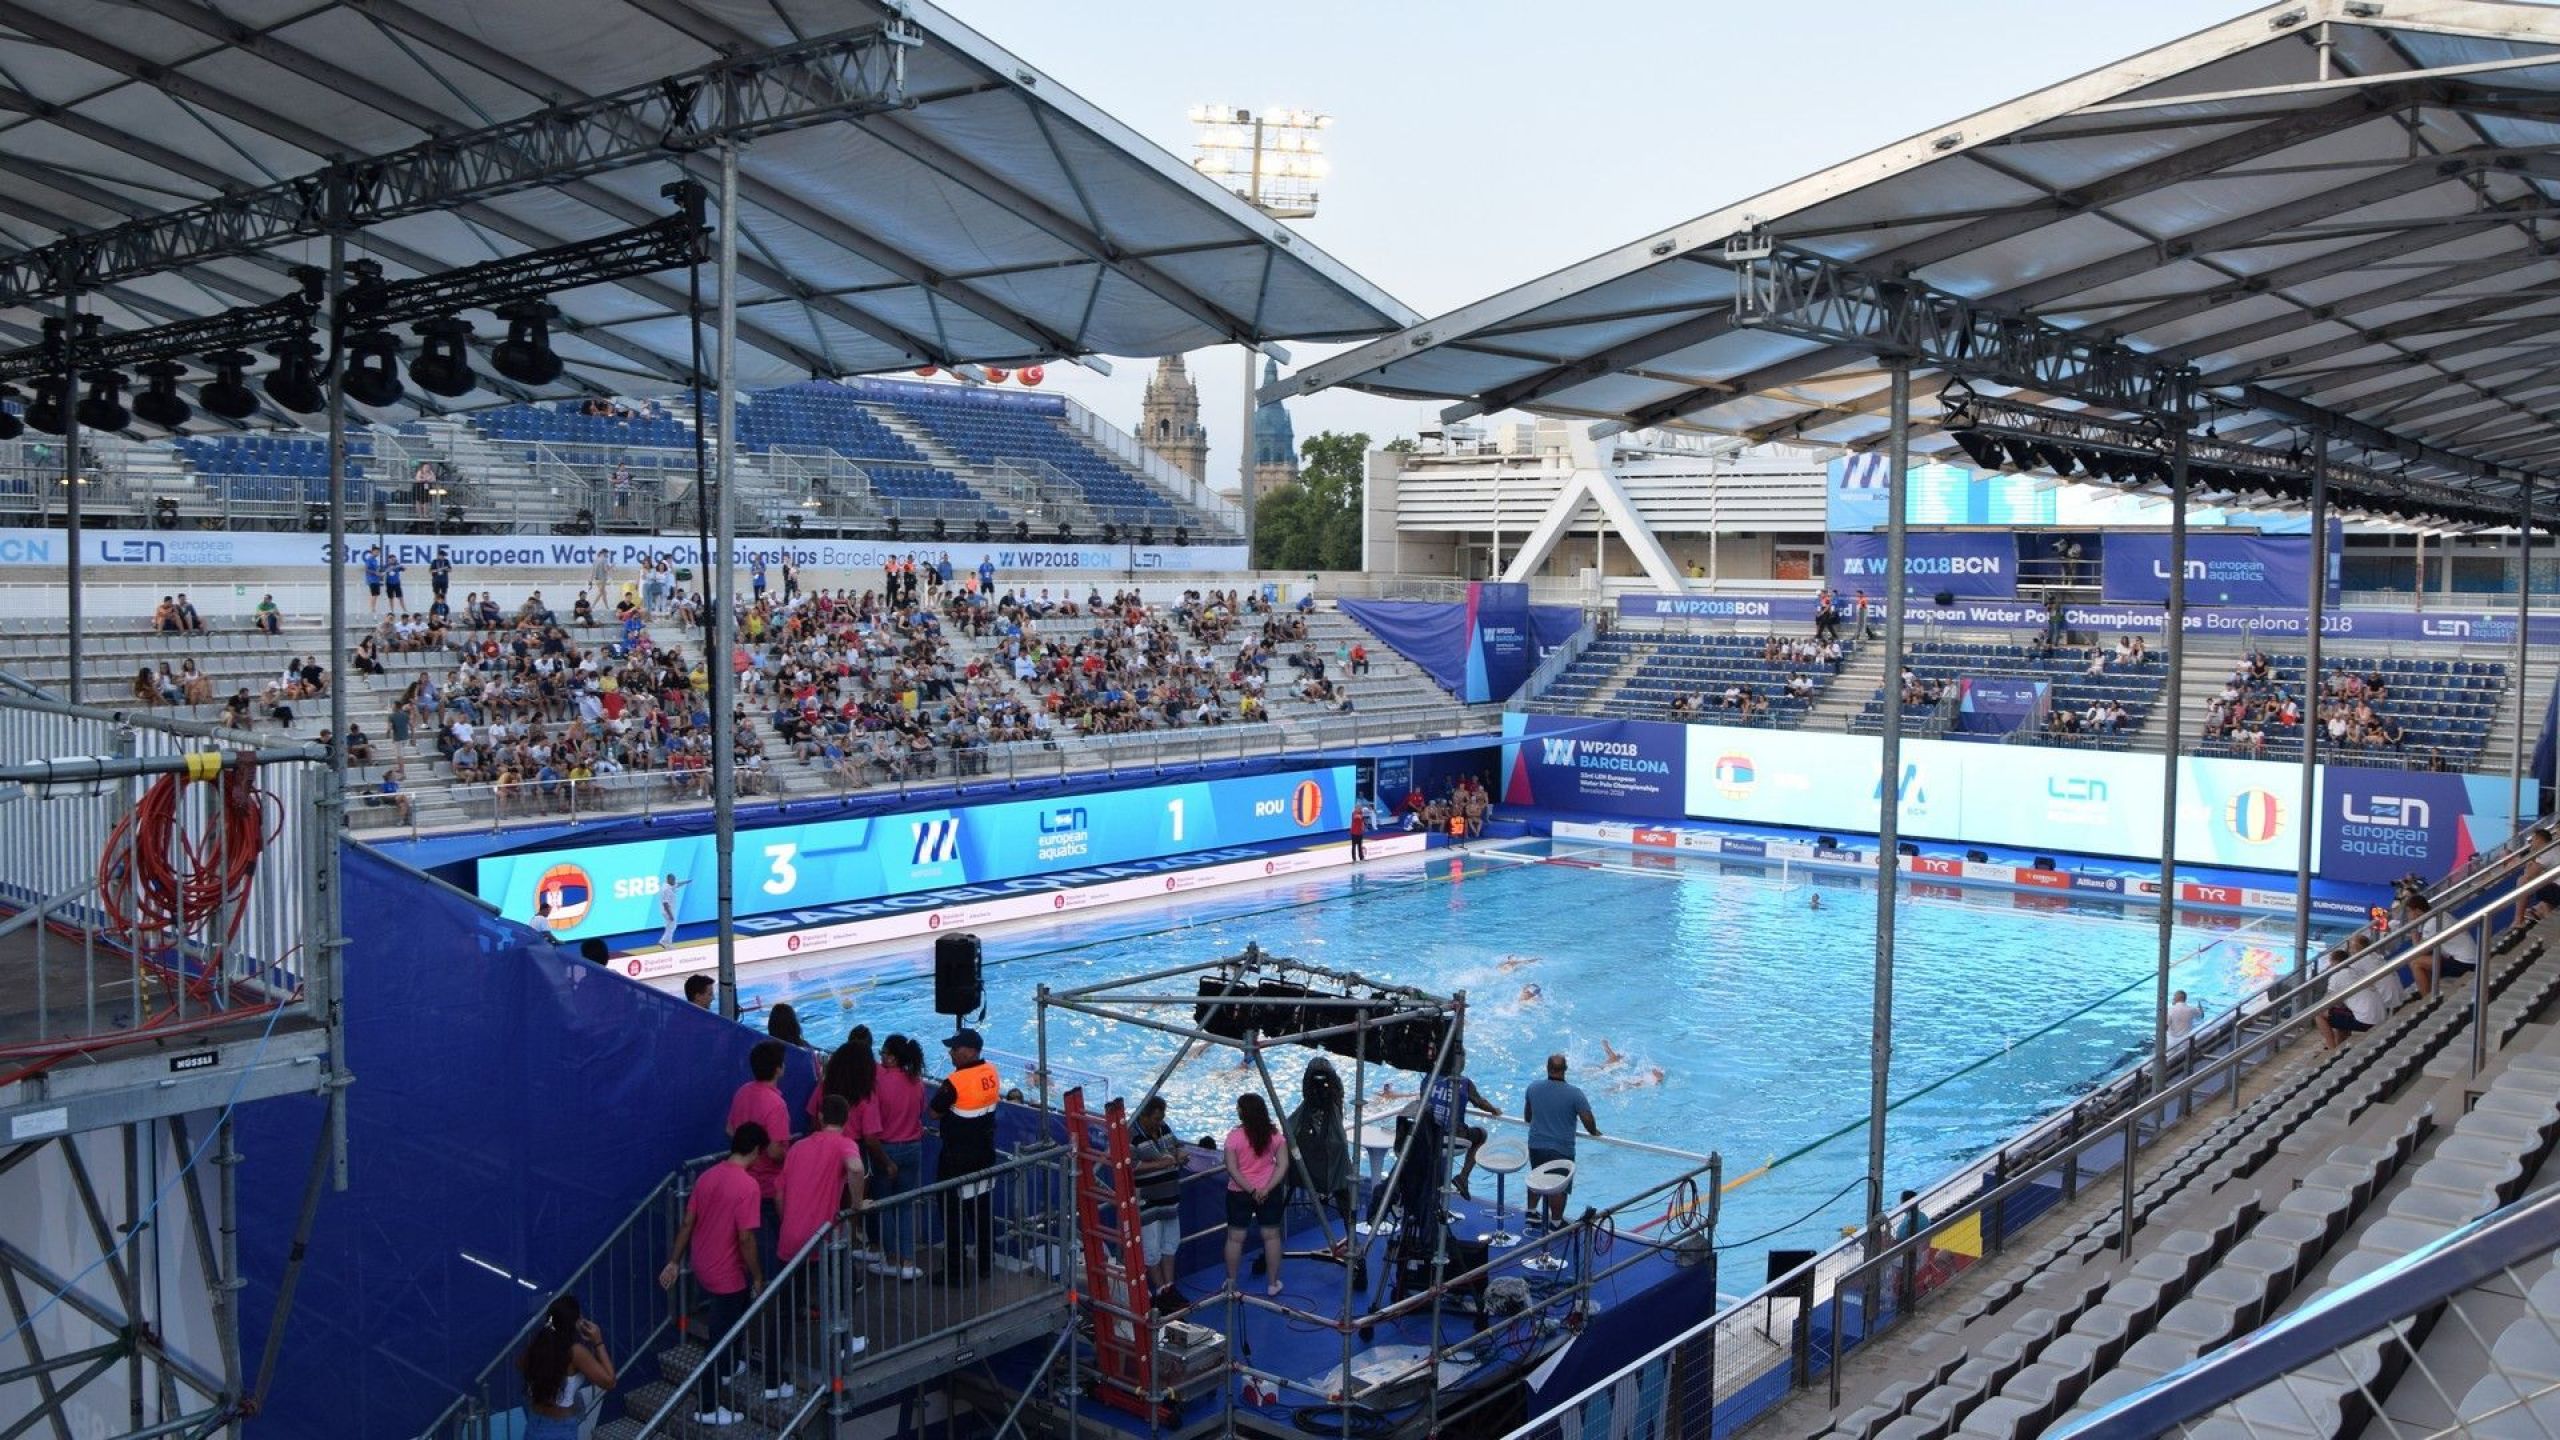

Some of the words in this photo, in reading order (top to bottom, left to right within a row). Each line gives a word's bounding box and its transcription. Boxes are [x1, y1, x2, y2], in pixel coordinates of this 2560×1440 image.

[101, 540, 165, 563] LEN
[169, 540, 233, 552] european
[169, 551, 233, 564] aquatics
[437, 544, 544, 566] uropean
[551, 544, 617, 564] Watr
[671, 545, 817, 568] Chpionships
[823, 546, 908, 567] Barcelo
[1867, 556, 2000, 575] W2018BCN
[2153, 559, 2206, 580] LN
[2208, 560, 2265, 572] european
[2208, 569, 2265, 582] aquatics
[1674, 600, 1769, 615] WP2018BCN
[1903, 607, 1967, 622] uropean
[1970, 607, 2022, 622] Water
[2066, 609, 2201, 629] Championshps
[2207, 613, 2300, 630] Barcelona
[2423, 619, 2470, 637] LEN
[1579, 740, 1638, 757] WP2018
[1579, 755, 1670, 774] BARCELONA
[1254, 799, 1286, 817] ROU
[2342, 792, 2430, 829] LEN
[1039, 806, 1088, 834] LEN
[1167, 797, 1185, 842] 1
[1038, 831, 1089, 848] european
[2341, 824, 2429, 842] european
[1038, 843, 1088, 861] aquatics
[2340, 838, 2428, 858] aquatics
[762, 842, 798, 896] 3
[1925, 859, 1950, 874] TYR
[613, 875, 661, 899] SRB
[2076, 877, 2105, 889] Allianz
[732, 864, 1155, 932] BARCELONA
[2198, 887, 2226, 901] TYR
[2312, 901, 2366, 914] EUROVISION
